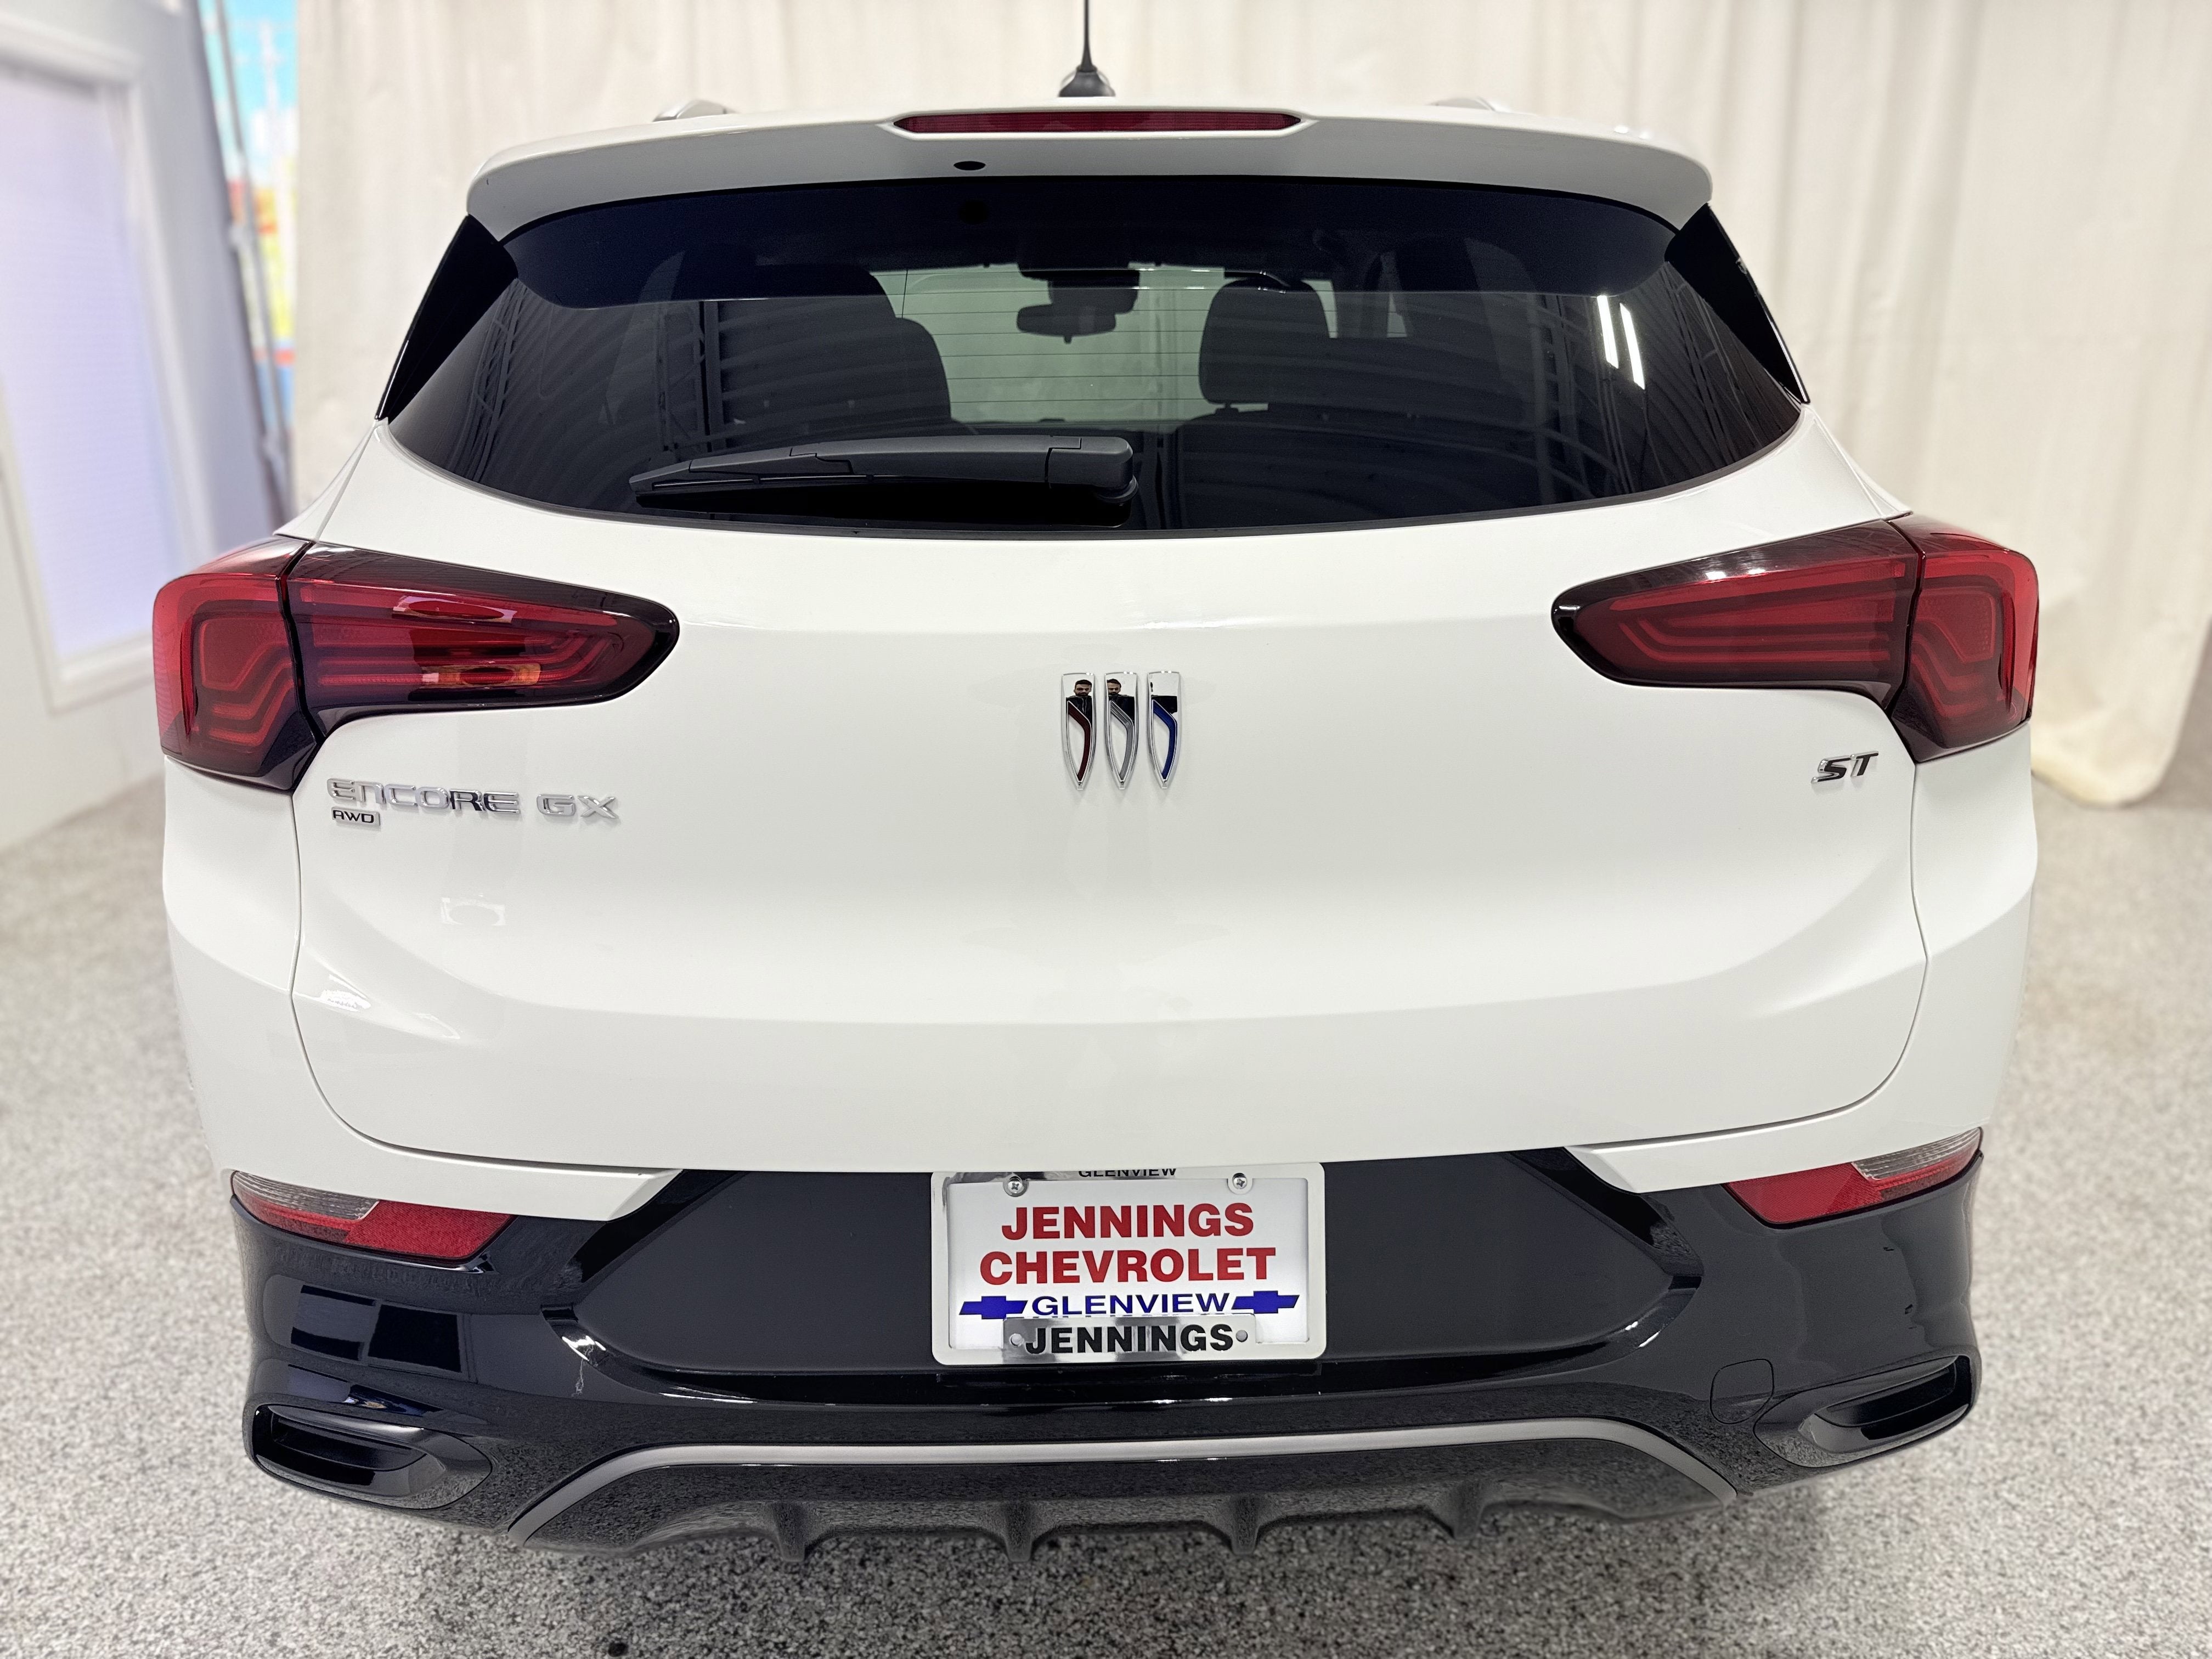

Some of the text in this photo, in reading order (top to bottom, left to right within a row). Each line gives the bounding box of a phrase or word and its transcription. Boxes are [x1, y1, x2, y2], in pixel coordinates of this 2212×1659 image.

[1811, 751, 1878, 783] ST
[327, 778, 619, 818] ENCORE GX
[332, 810, 374, 823] AWD
[1079, 1168, 1176, 1177] GLENVIEW
[1002, 1203, 1254, 1240] JENNINGS
[980, 1247, 1276, 1285] CHEVROLET
[1032, 1293, 1230, 1316] GLENVIEW
[1025, 1324, 1233, 1354] JENNINGS
